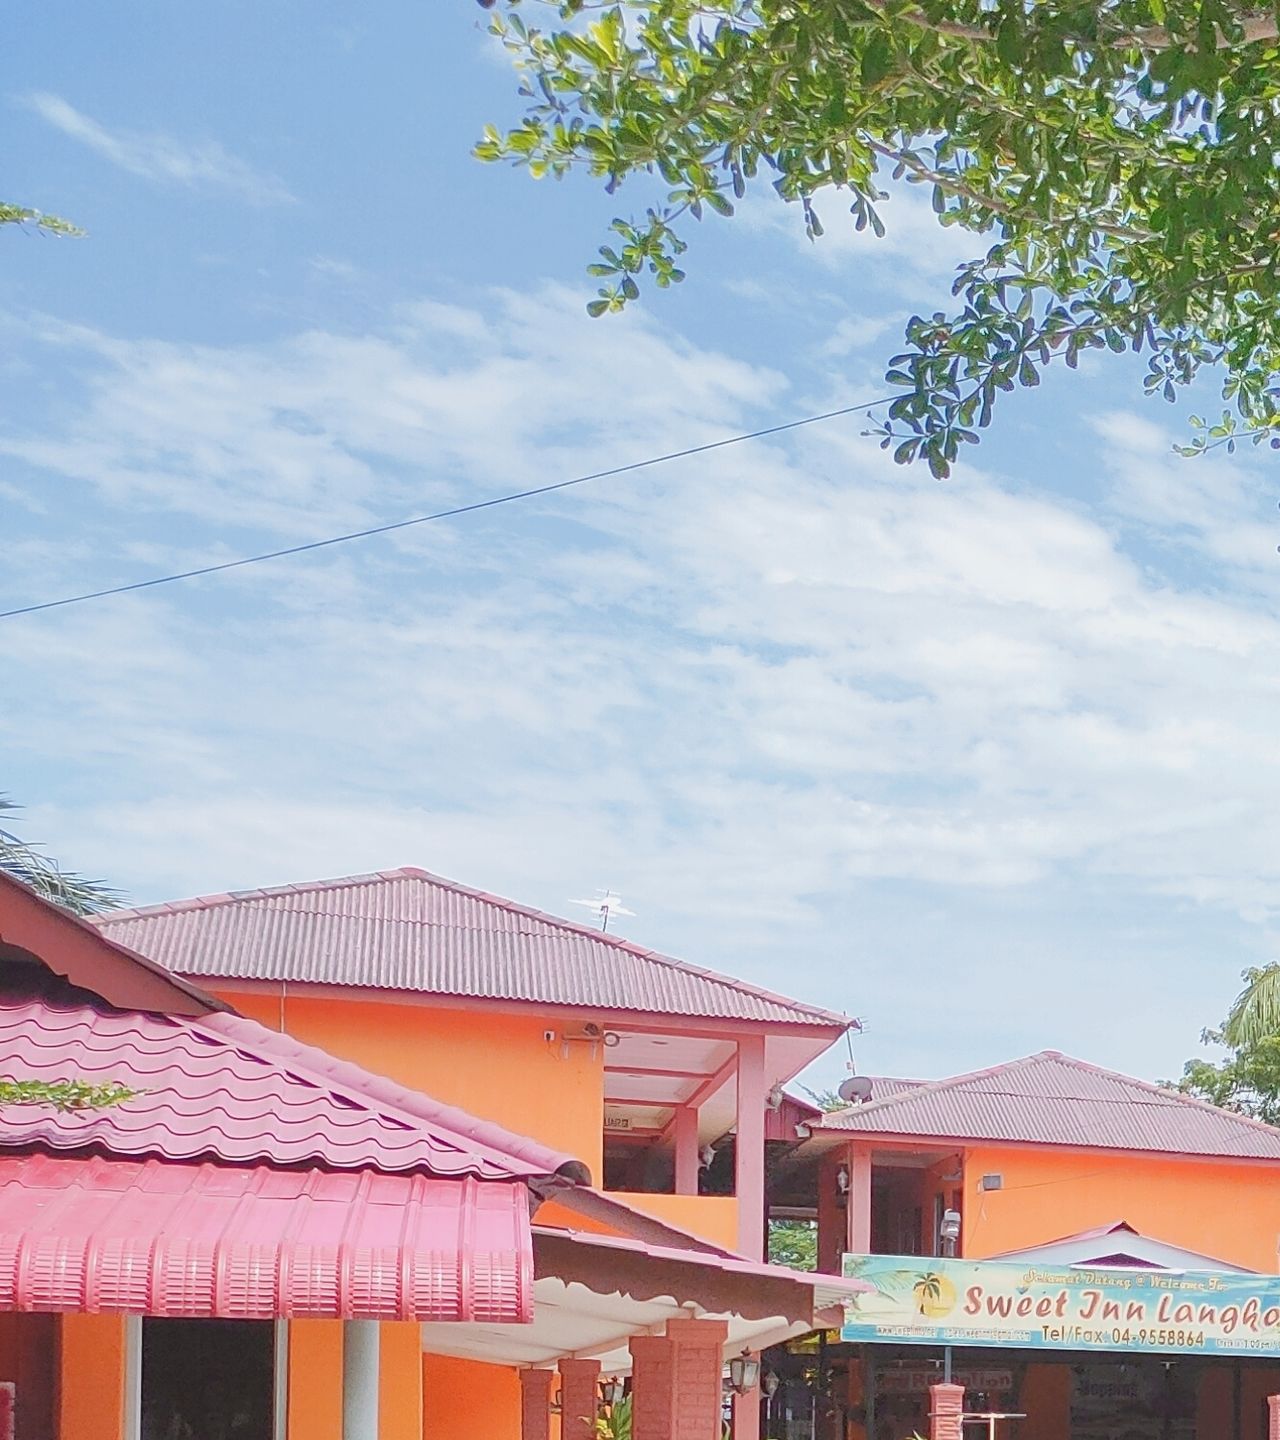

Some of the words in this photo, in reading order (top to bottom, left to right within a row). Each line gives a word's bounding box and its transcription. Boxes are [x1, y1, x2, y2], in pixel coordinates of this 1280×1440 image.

[963, 1285, 1069, 1318] Sweet
[1079, 1290, 1145, 1322] Inn
[1111, 1328, 1205, 1347] 04-9558864
